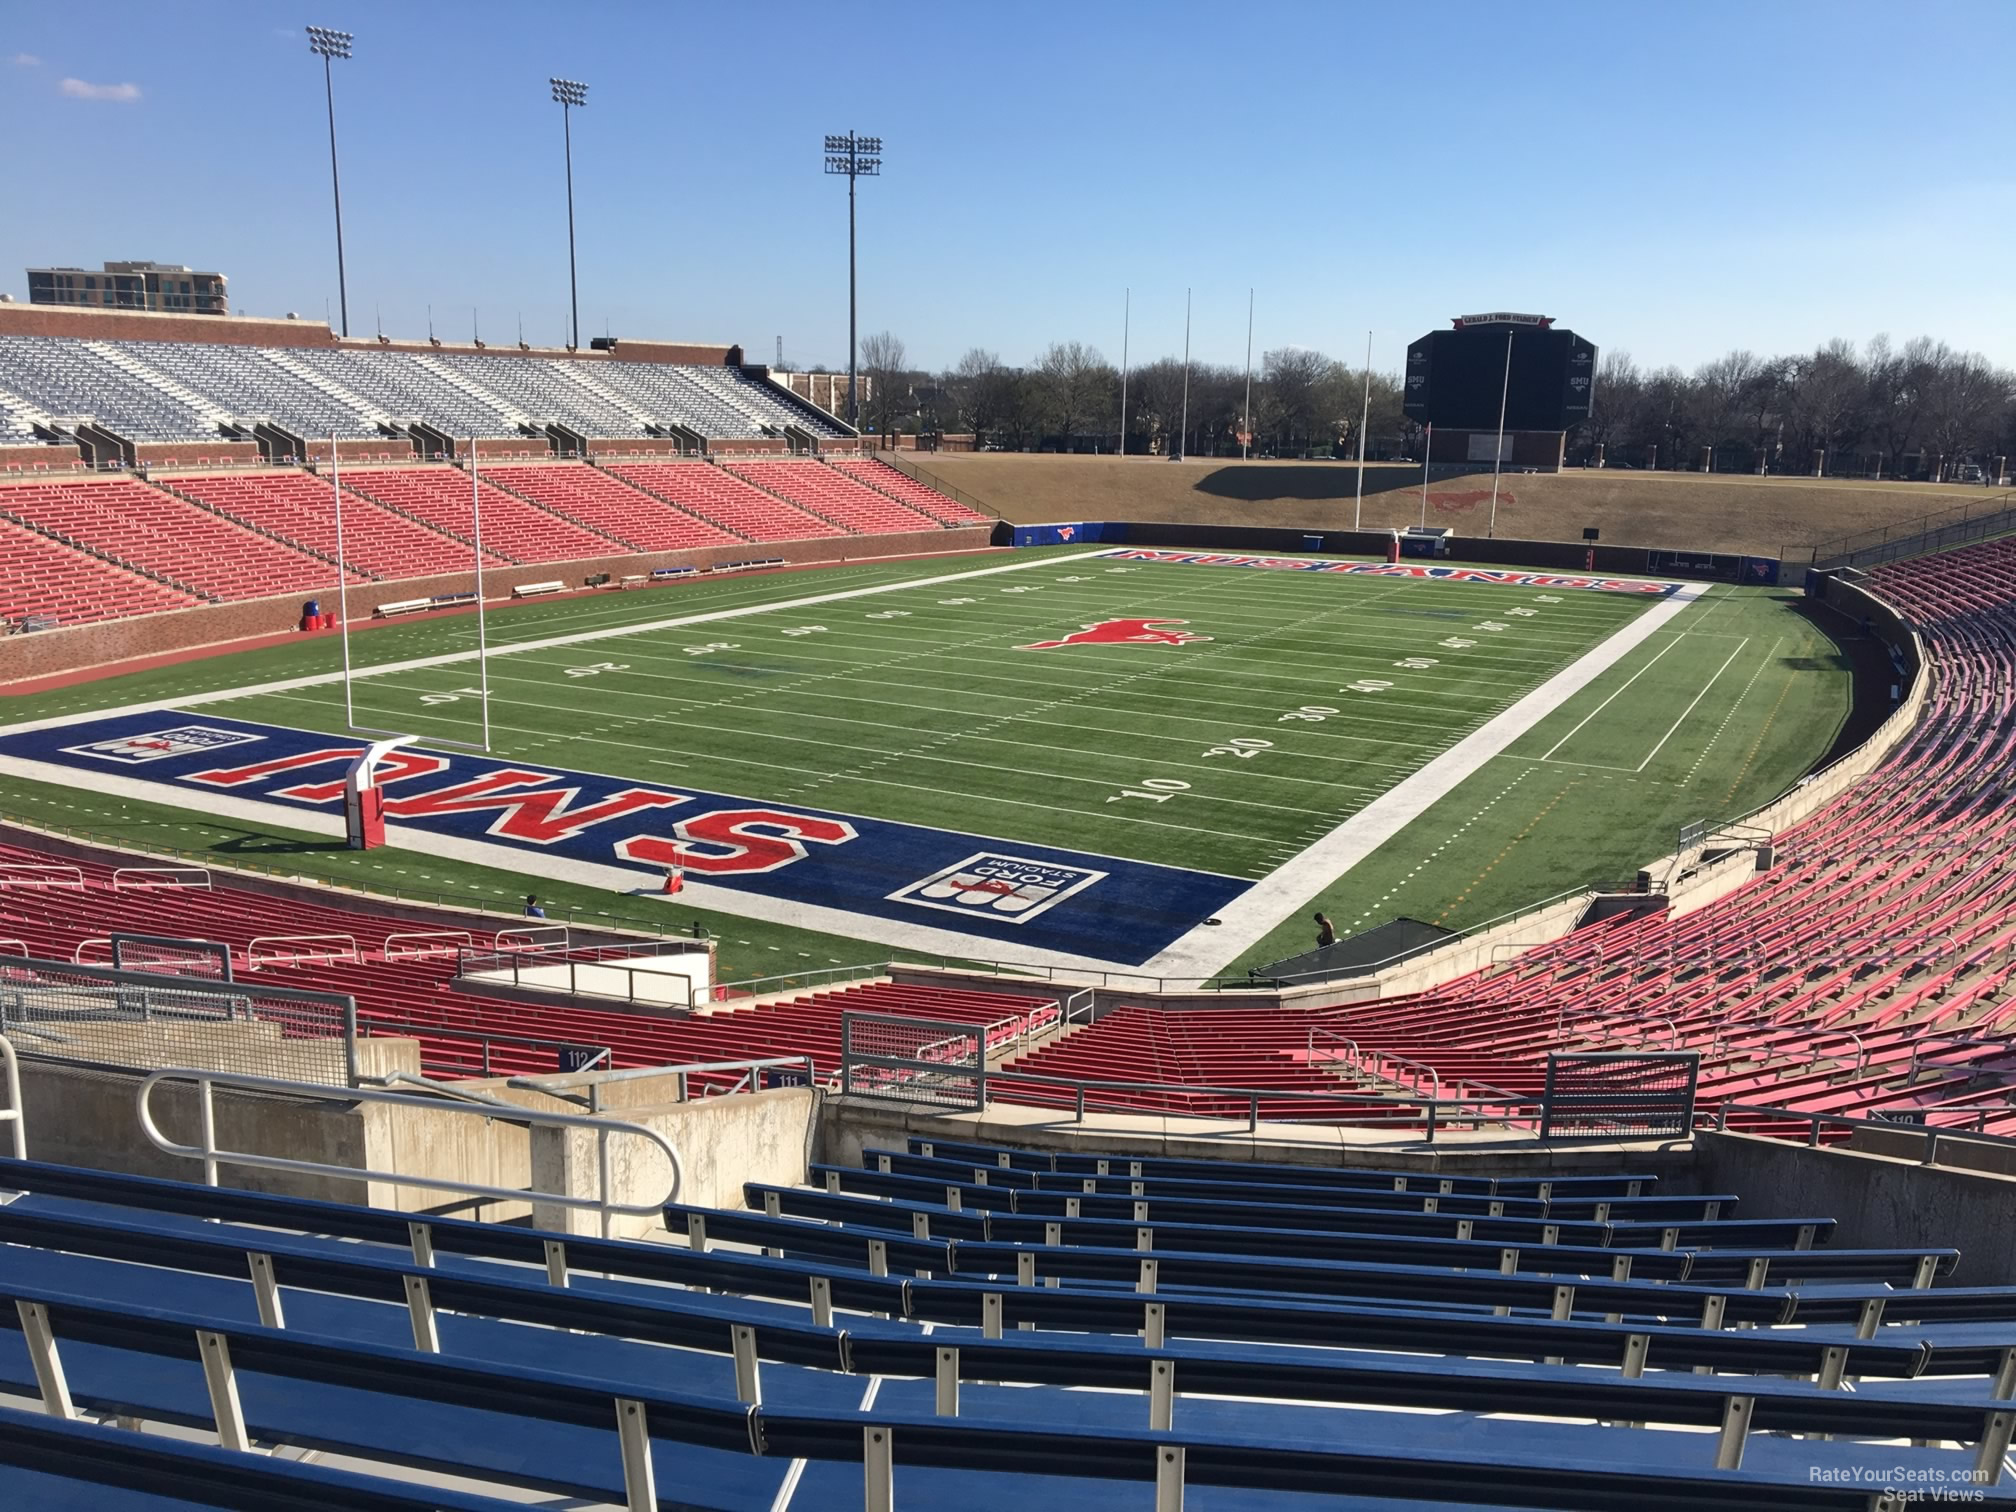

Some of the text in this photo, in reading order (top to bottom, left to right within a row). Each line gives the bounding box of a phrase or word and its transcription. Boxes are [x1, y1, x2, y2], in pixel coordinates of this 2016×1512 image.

[1512, 315, 1539, 323] STADIUM
[1407, 375, 1425, 384] SMU
[1570, 377, 1590, 386] SMU
[1100, 549, 1671, 593] MUSTANGS
[682, 642, 742, 654] 30
[564, 662, 631, 676] 20
[1393, 657, 1440, 669] 50
[1346, 679, 1394, 692] 40
[419, 687, 494, 703] 10
[1283, 706, 1340, 722] 30
[162, 733, 224, 745] FORD
[1210, 738, 1274, 758] 20
[1121, 779, 1192, 803] 10
[177, 748, 859, 875] SMU
[987, 859, 1078, 879] STADIUM
[974, 866, 1066, 888] FORD
[568, 1051, 589, 1067] 112
[779, 1075, 798, 1087] 111
